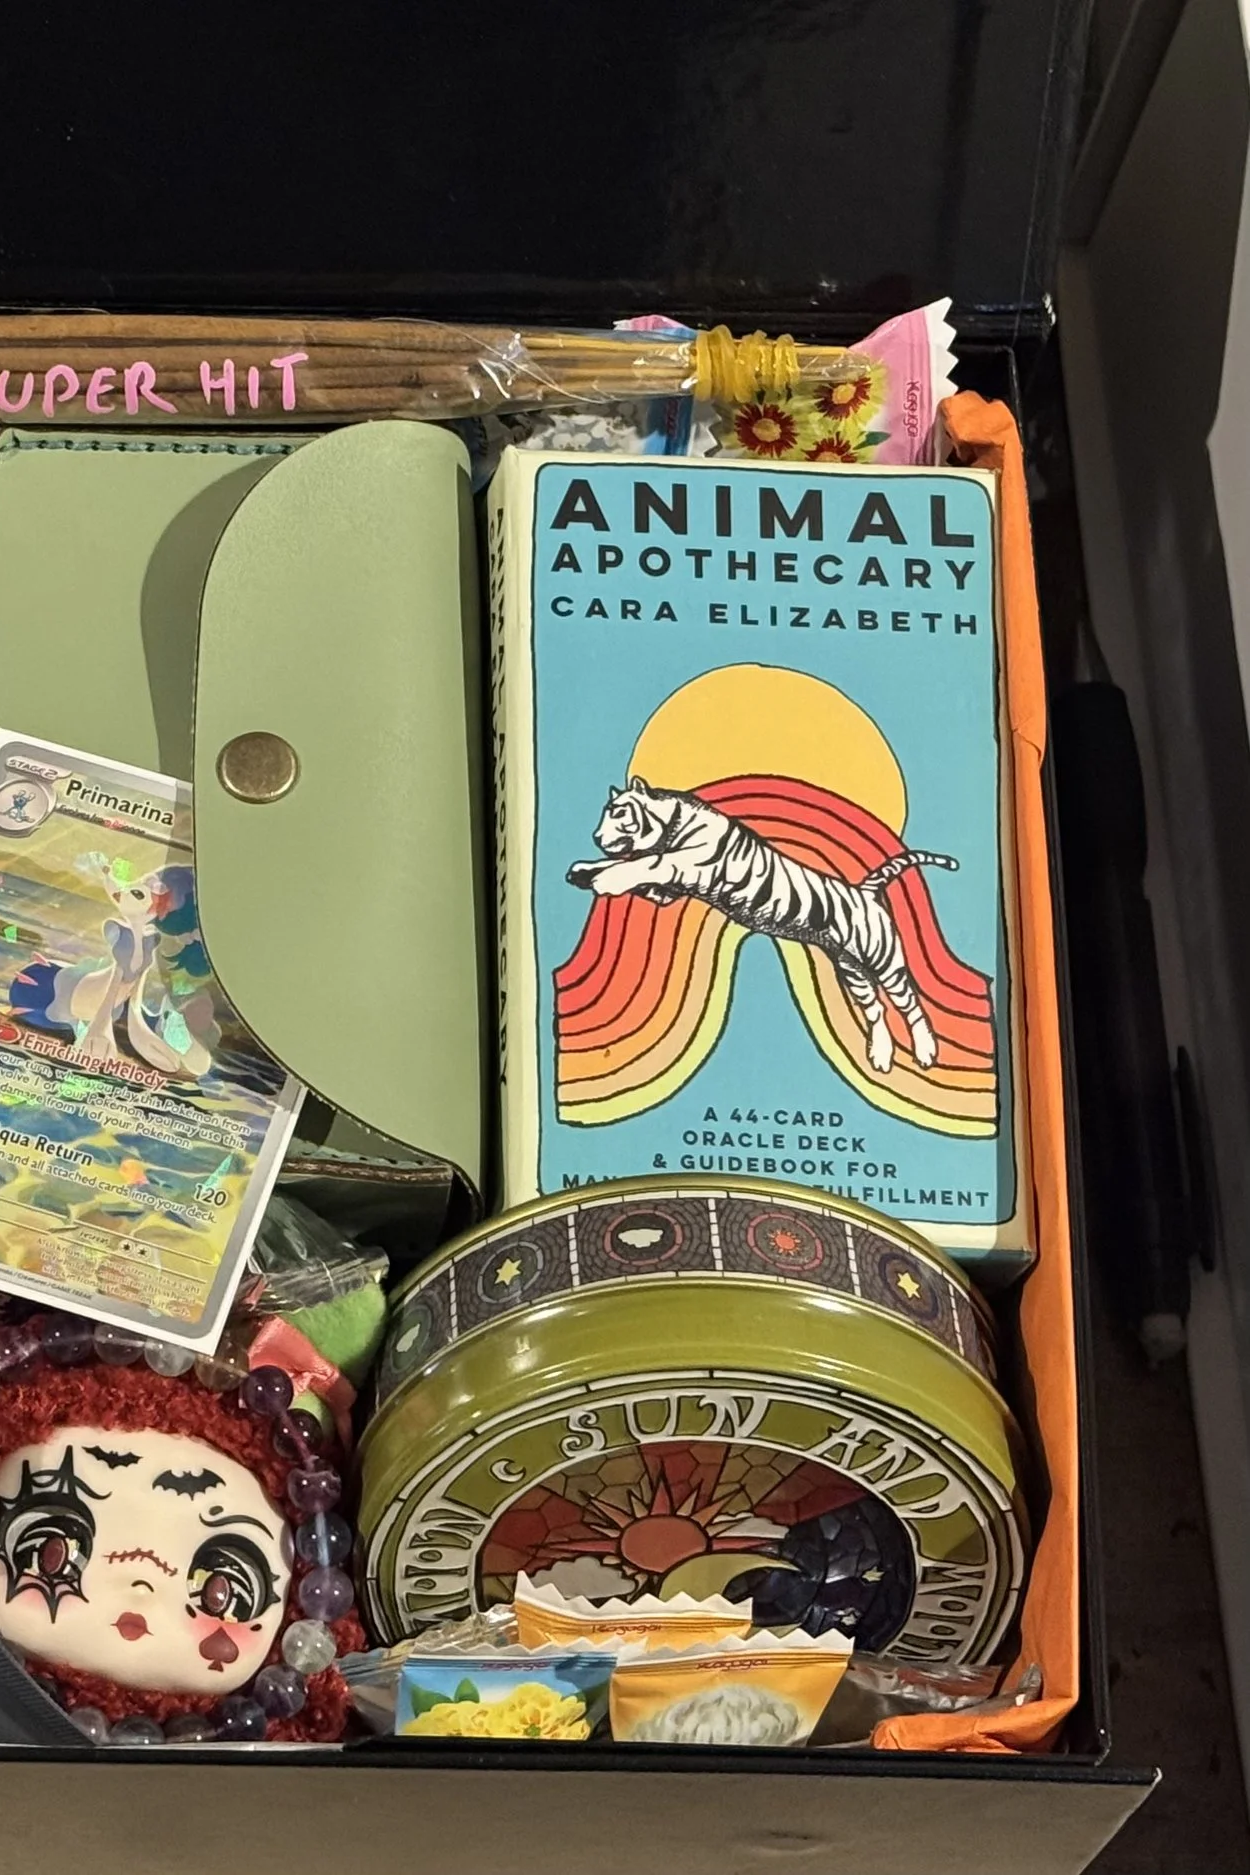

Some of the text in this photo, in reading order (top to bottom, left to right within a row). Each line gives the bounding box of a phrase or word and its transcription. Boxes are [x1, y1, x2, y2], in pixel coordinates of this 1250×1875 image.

[199, 352, 309, 416] HIT
[550, 478, 975, 548] ANIMAL
[550, 542, 976, 591] APOTHECARY
[550, 595, 979, 636] CARA ELIZABETH
[65, 779, 174, 826] Primarina
[23, 1032, 100, 1073] Enriching
[105, 1057, 166, 1091] Melody
[0, 1081, 43, 1105] damage
[46, 1095, 76, 1114] from
[87, 1106, 103, 1121] of
[103, 1114, 133, 1131] your
[25, 1060, 53, 1078] turn,
[140, 1093, 163, 1109] this
[165, 1099, 220, 1127] Pokémon
[221, 1118, 252, 1136] from
[43, 1079, 57, 1092] of
[147, 1111, 172, 1127] you
[171, 1119, 199, 1138] may
[199, 1127, 223, 1143] use
[223, 1133, 246, 1151] this
[702, 1106, 845, 1129] A 44-CARD
[33, 1135, 94, 1167] Return
[194, 1183, 228, 1207] 120
[652, 1153, 899, 1180] & GUIDEBOOK FOR
[682, 1130, 867, 1154] ORACLE DECK
[6, 1150, 31, 1167] and
[30, 1158, 45, 1172] all
[45, 1162, 97, 1187] attached
[98, 1178, 131, 1198] cards
[130, 1189, 156, 1206] into
[155, 1199, 185, 1216] your
[561, 1393, 772, 1459] SUN
[809, 1410, 970, 1521] AND
